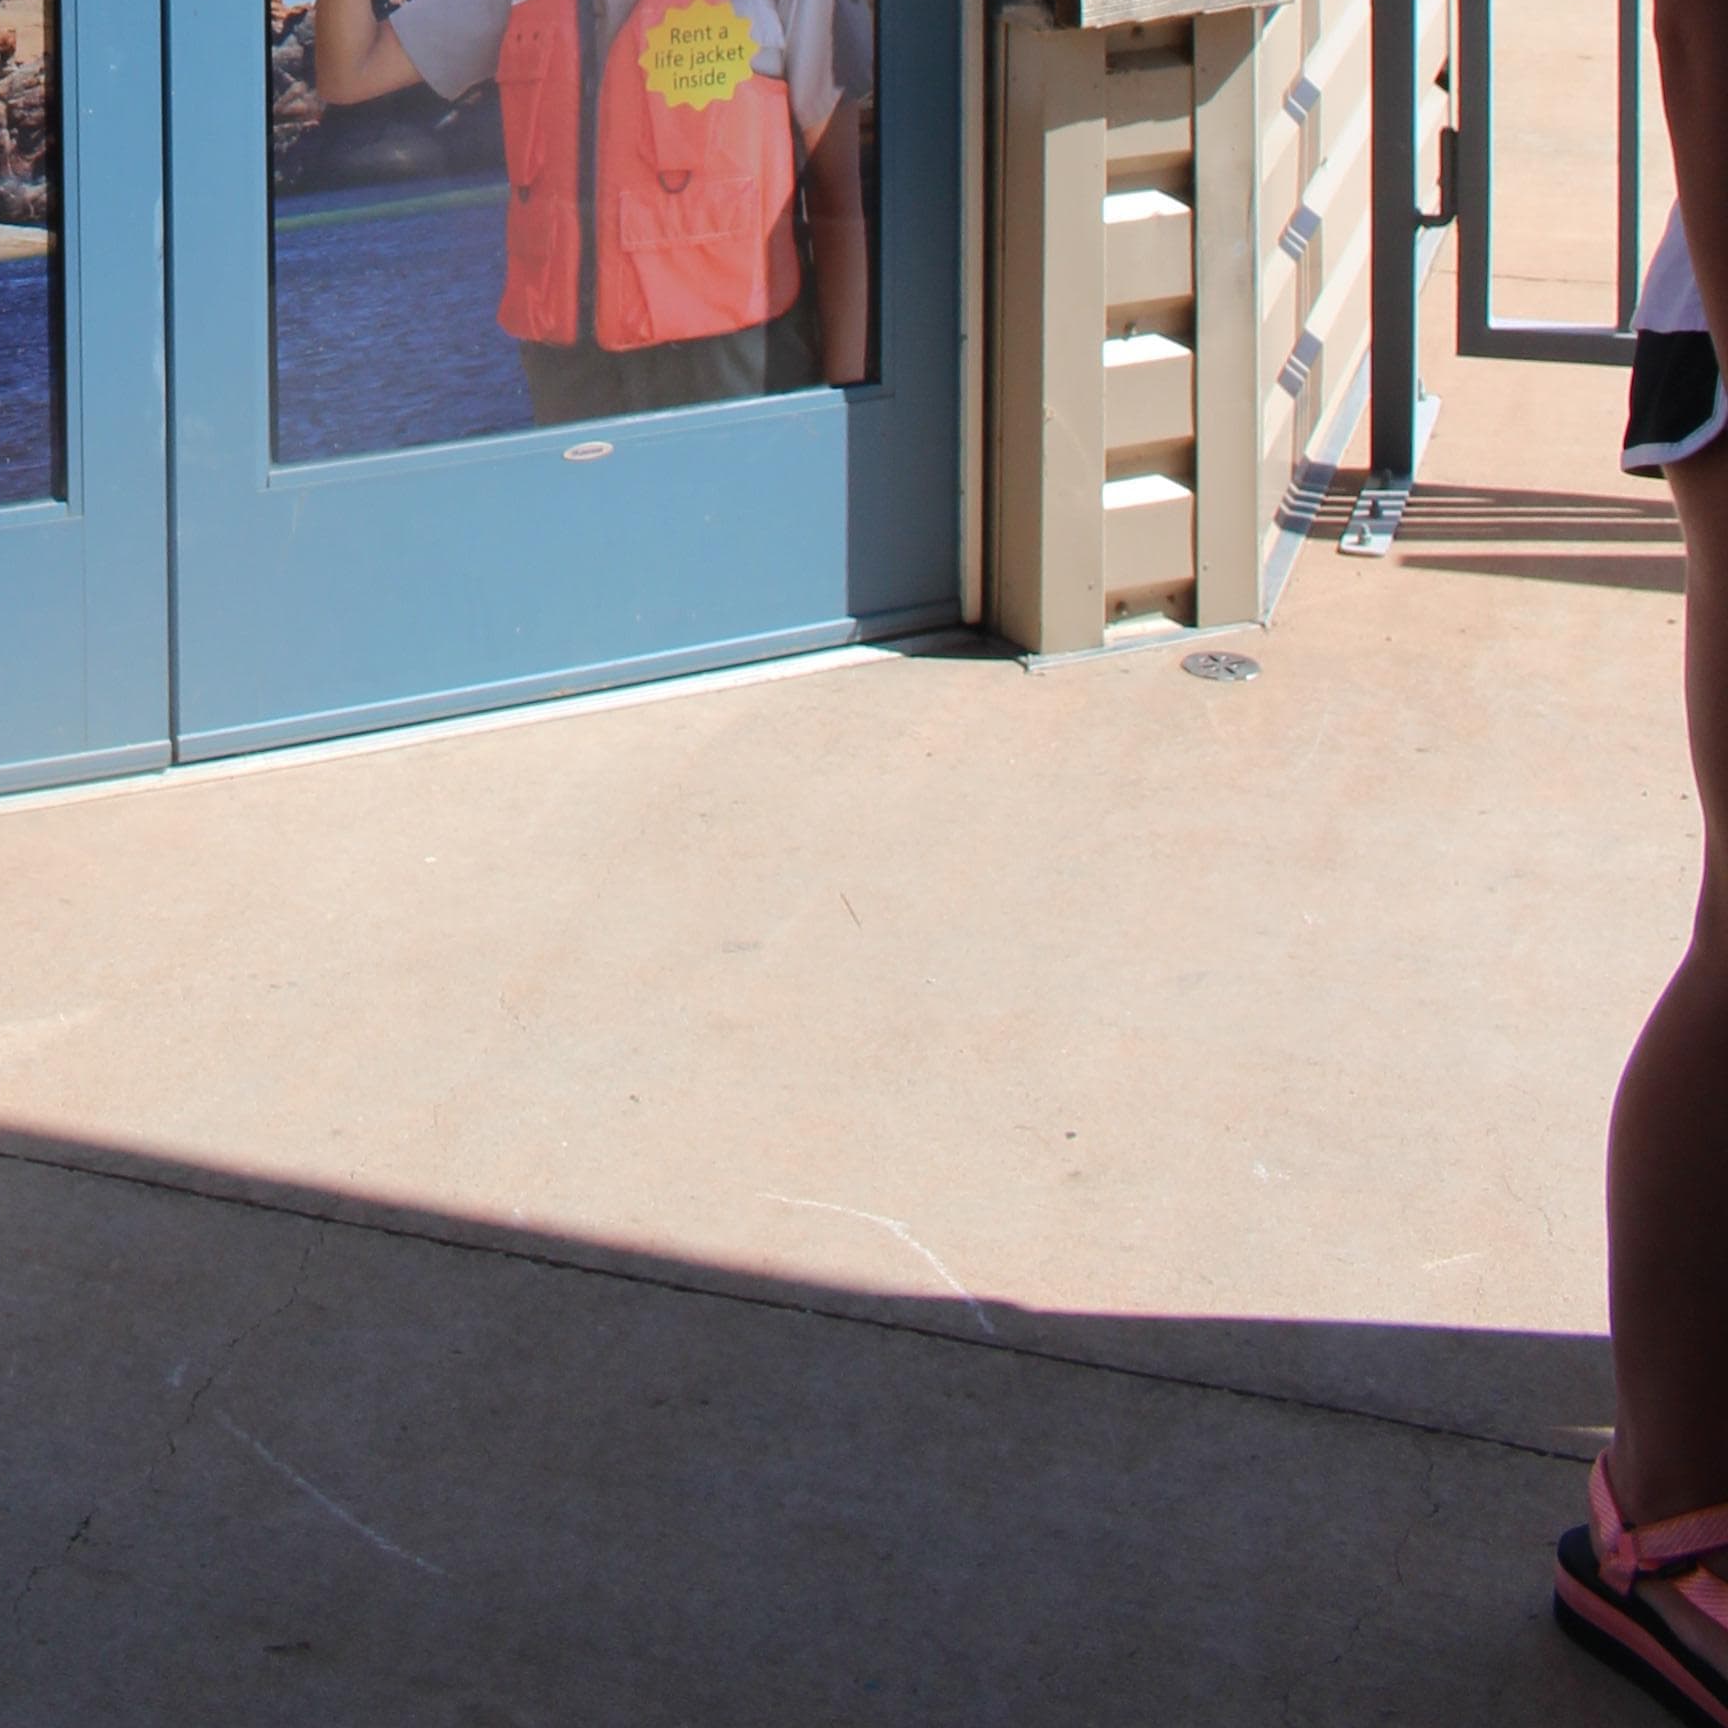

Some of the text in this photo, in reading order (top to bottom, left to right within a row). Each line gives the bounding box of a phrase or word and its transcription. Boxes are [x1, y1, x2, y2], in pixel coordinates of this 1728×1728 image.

[670, 25, 729, 44] Rent a
[654, 45, 745, 70] life jacket
[672, 68, 727, 90] inside
